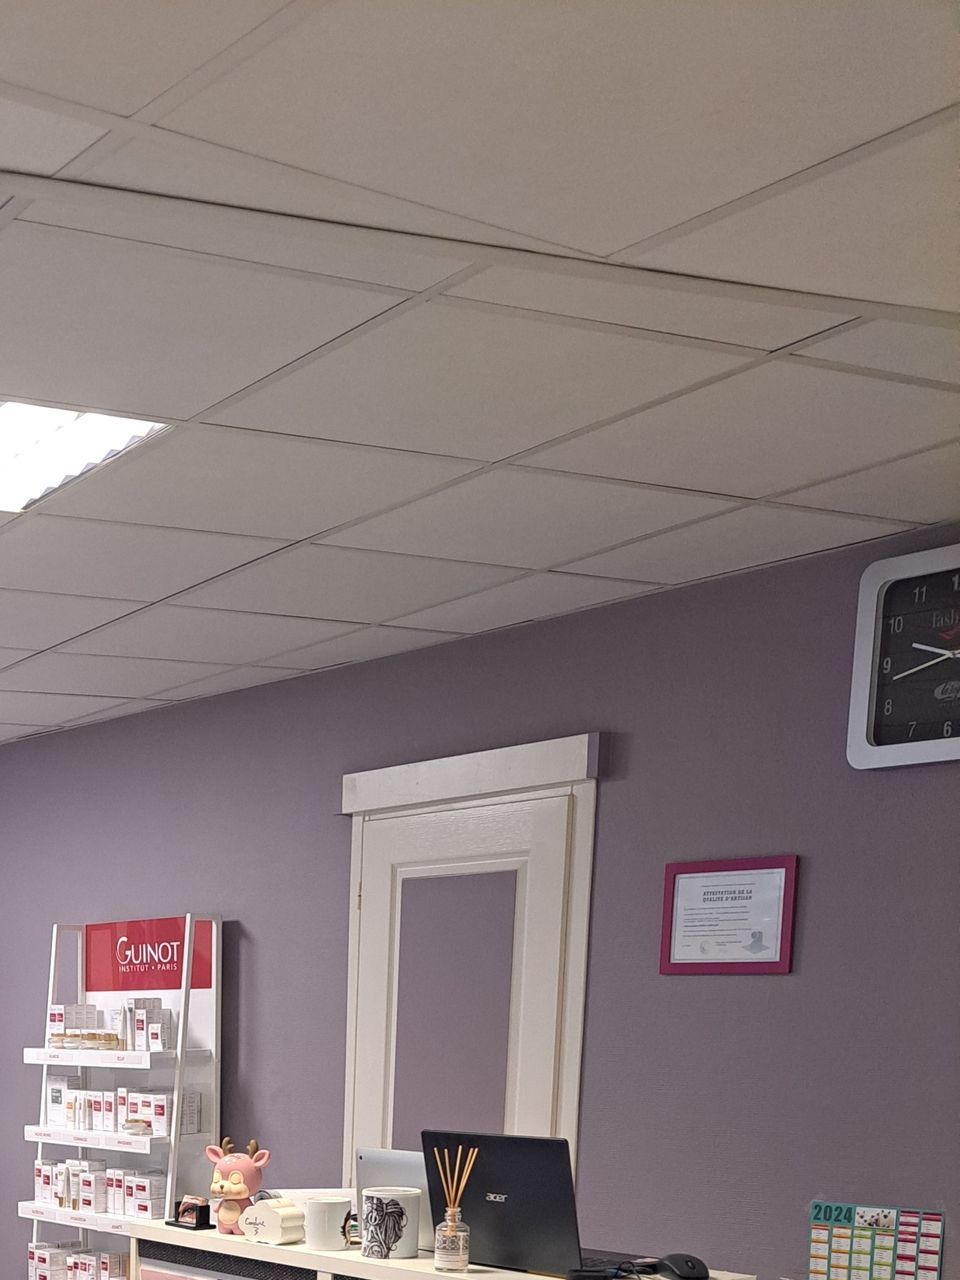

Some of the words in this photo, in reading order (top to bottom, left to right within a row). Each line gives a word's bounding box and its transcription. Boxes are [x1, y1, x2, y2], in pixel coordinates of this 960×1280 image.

[913, 585, 927, 604] 11
[888, 615, 904, 634] 10
[883, 657, 892, 674] 9
[883, 699, 893, 716] 8
[908, 721, 917, 738] 7
[943, 720, 952, 737] 6
[118, 964, 149, 973] INSTITUT
[157, 963, 178, 971] PARIS
[485, 1192, 508, 1203] acer
[813, 1204, 853, 1223] 2024
